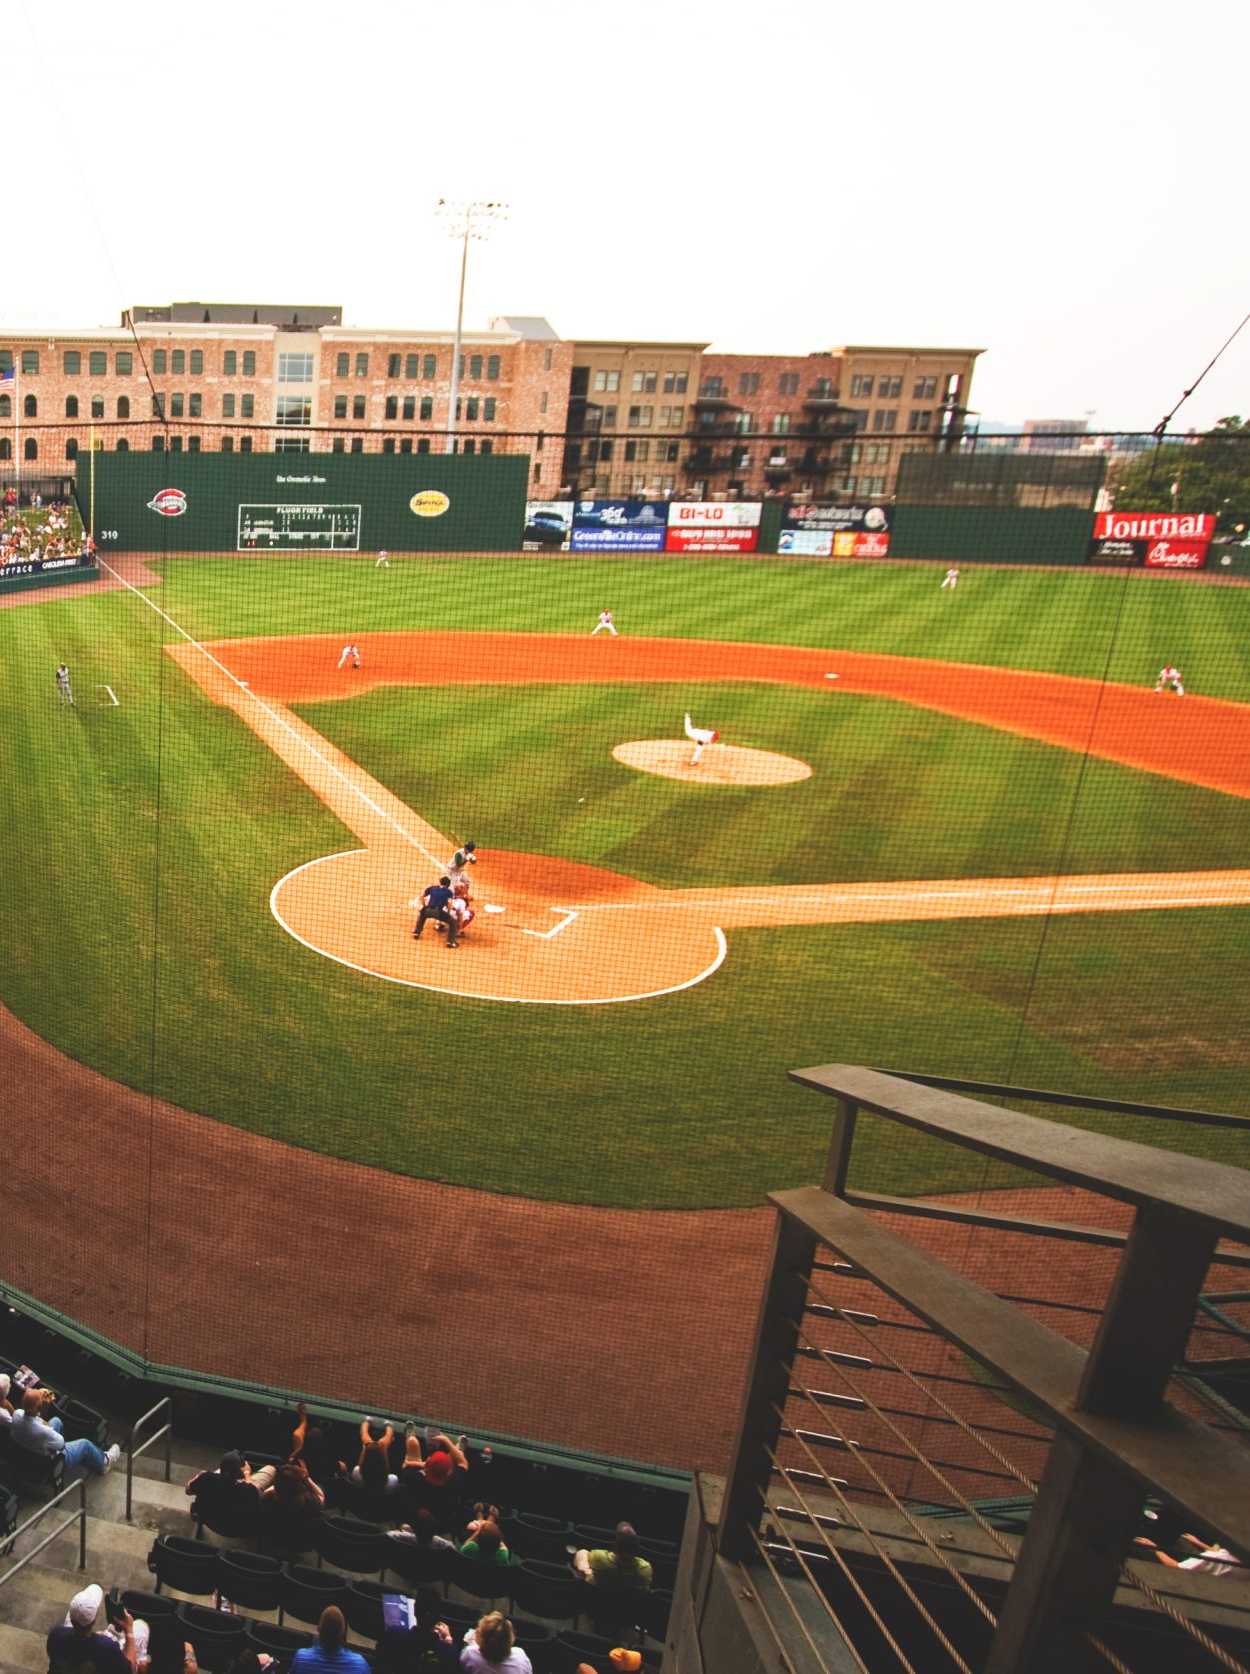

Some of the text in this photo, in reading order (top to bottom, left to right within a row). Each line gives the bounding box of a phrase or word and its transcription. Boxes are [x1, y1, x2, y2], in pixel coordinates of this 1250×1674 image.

[679, 508, 723, 519] BI-LO
[1098, 512, 1205, 539] Journal
[101, 530, 118, 539] 310
